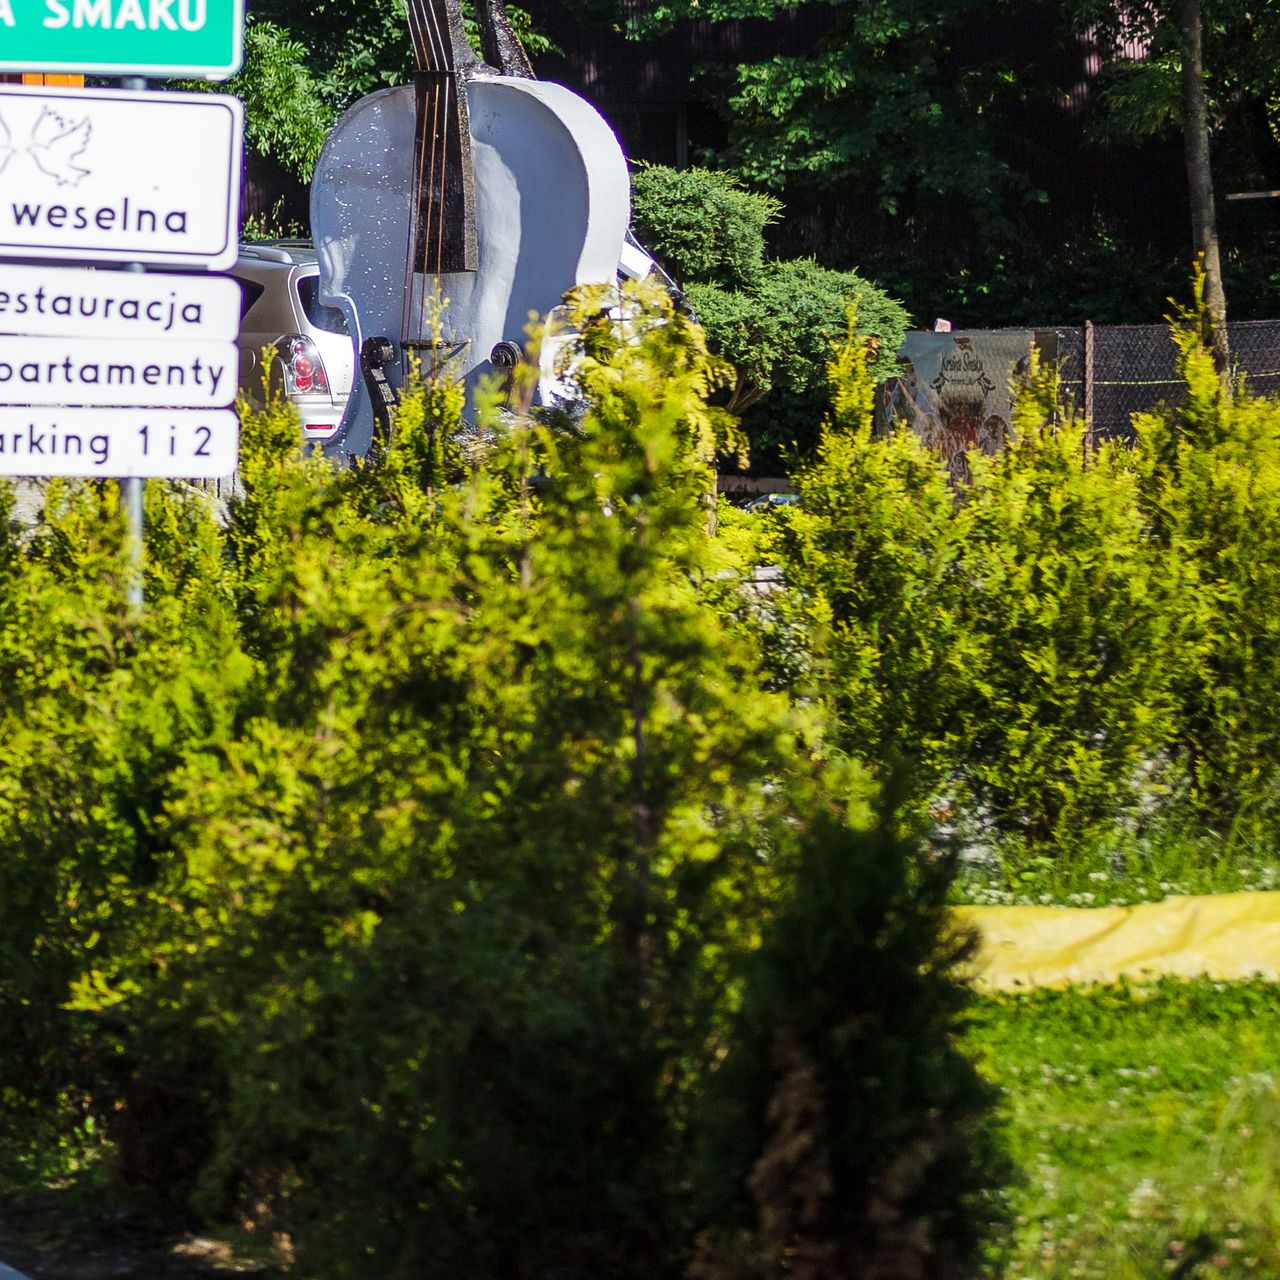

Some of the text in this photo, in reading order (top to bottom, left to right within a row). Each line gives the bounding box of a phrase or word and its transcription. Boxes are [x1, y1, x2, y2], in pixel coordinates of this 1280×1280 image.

[12, 197, 188, 234] weselna
[138, 425, 149, 456] 1
[169, 427, 176, 456] i
[194, 425, 212, 456] 2
